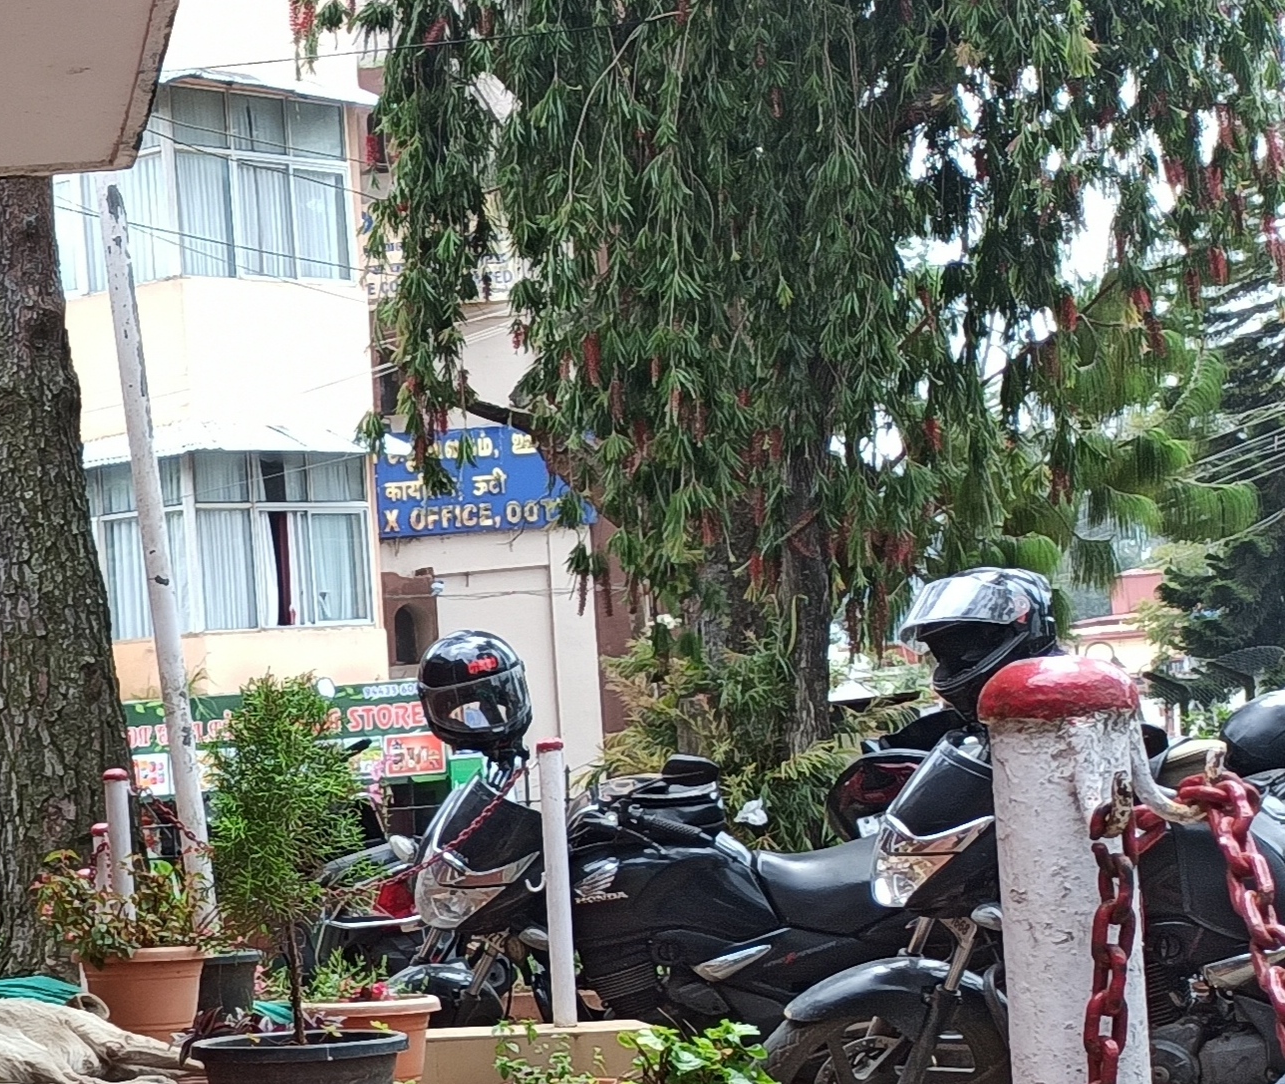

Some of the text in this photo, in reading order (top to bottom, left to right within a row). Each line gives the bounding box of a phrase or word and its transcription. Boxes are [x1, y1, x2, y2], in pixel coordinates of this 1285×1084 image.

[409, 502, 501, 531] OFFICE,
[506, 500, 568, 524] OOT
[574, 891, 629, 904] HONDA
